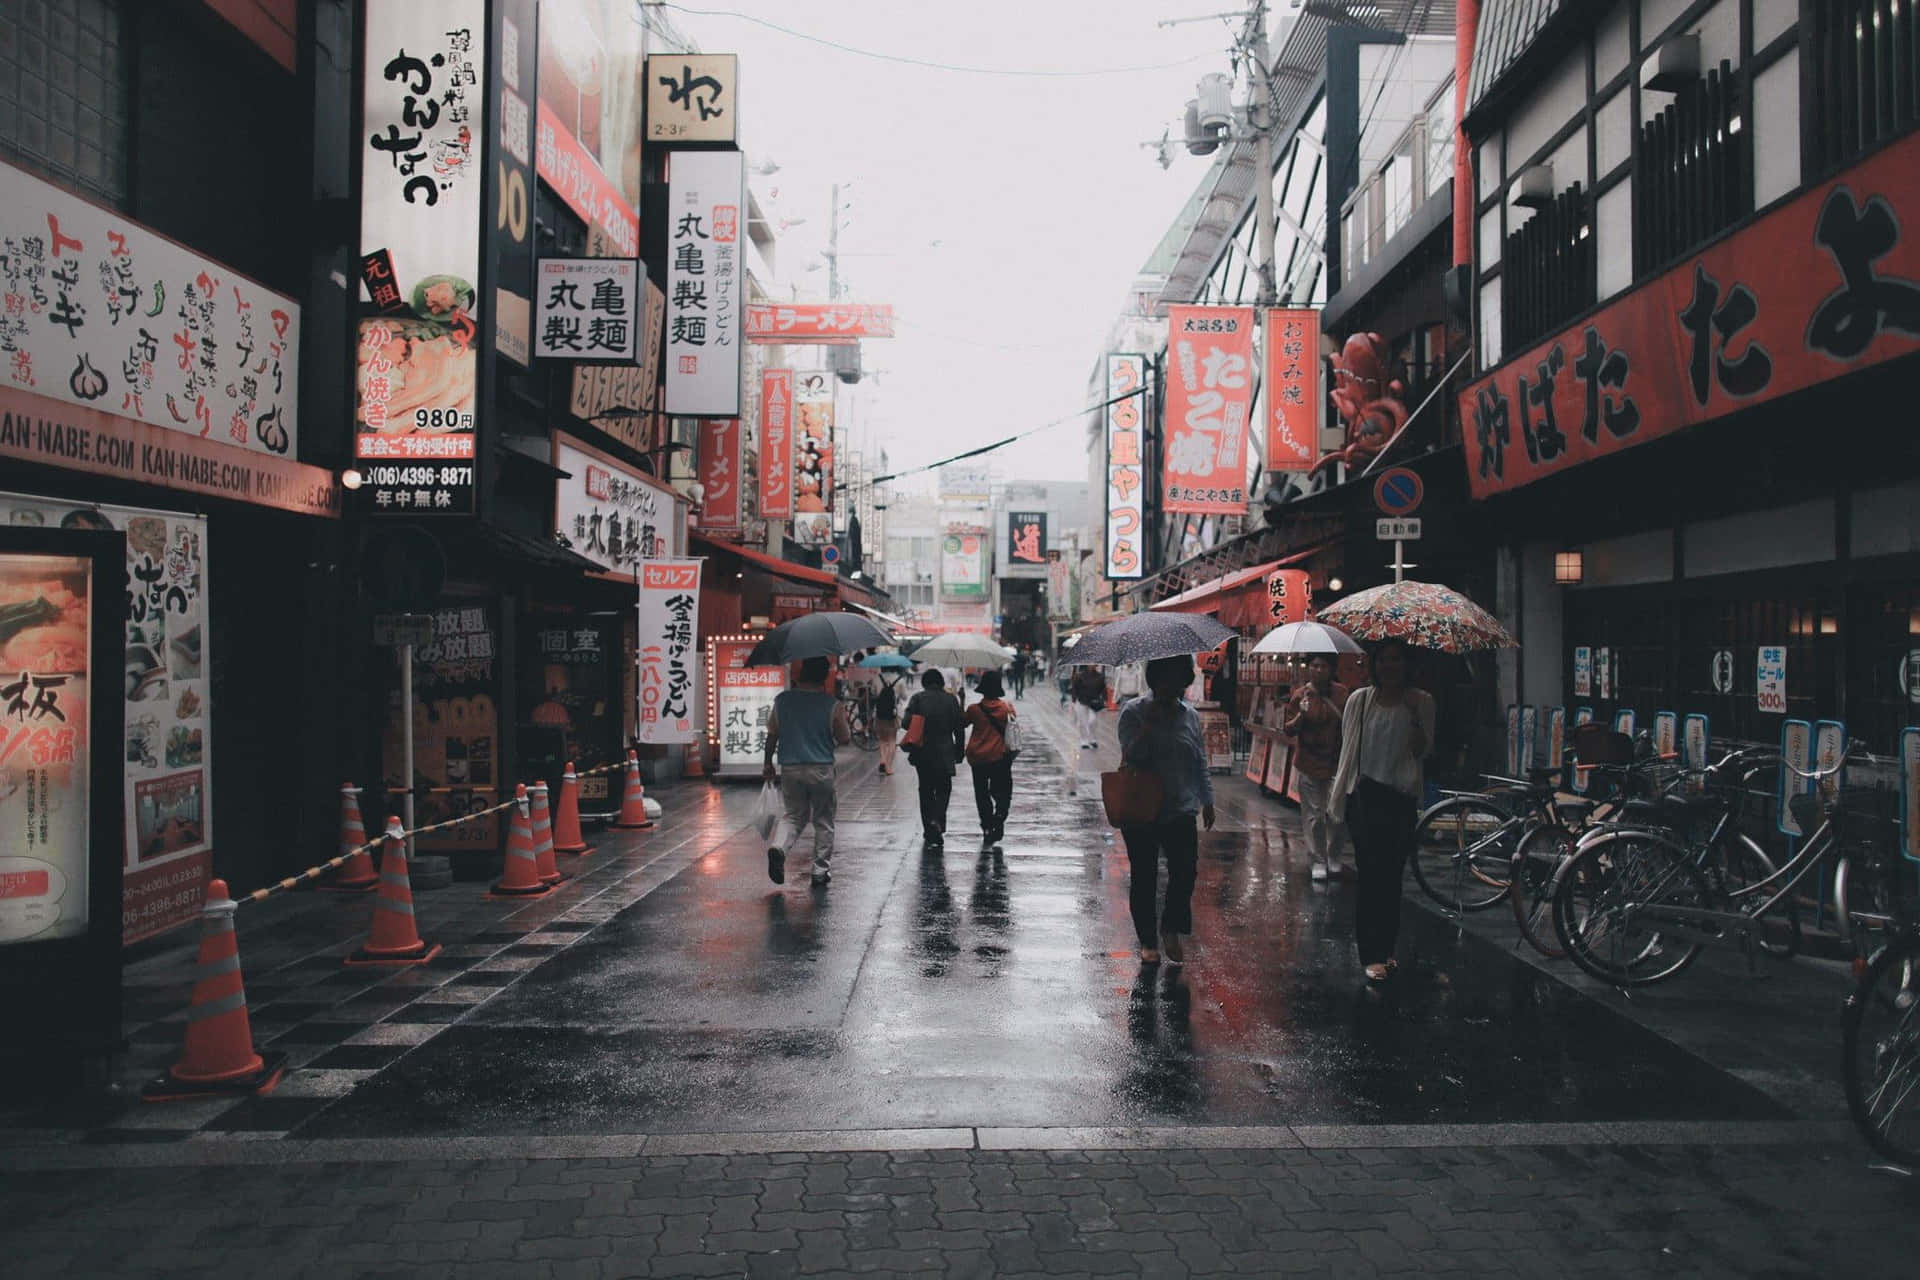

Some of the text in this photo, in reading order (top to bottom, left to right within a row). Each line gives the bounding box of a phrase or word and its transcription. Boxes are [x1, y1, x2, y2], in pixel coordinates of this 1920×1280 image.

[659, 65, 724, 122] わん
[363, 256, 398, 307] 元祖
[669, 212, 709, 347] 丸亀製麺
[713, 244, 734, 347] 釜揚げうどん
[363, 324, 391, 428] かん焼き
[1278, 321, 1304, 405] お好み焼
[414, 408, 474, 428] 980円
[1168, 345, 1246, 477] たこ焼
[142, 444, 250, 493] KAN-NABE.COM
[358, 438, 474, 458] 宴会ご予約受付中
[1107, 360, 1141, 573] うる星やつら
[373, 466, 473, 487] (06)4396-8871
[374, 488, 452, 508] 年中無休
[647, 567, 698, 587] セルフ
[1269, 577, 1288, 630] 焼そ
[661, 593, 695, 720] 釜揚げうどん
[1758, 665, 1785, 680] ビール
